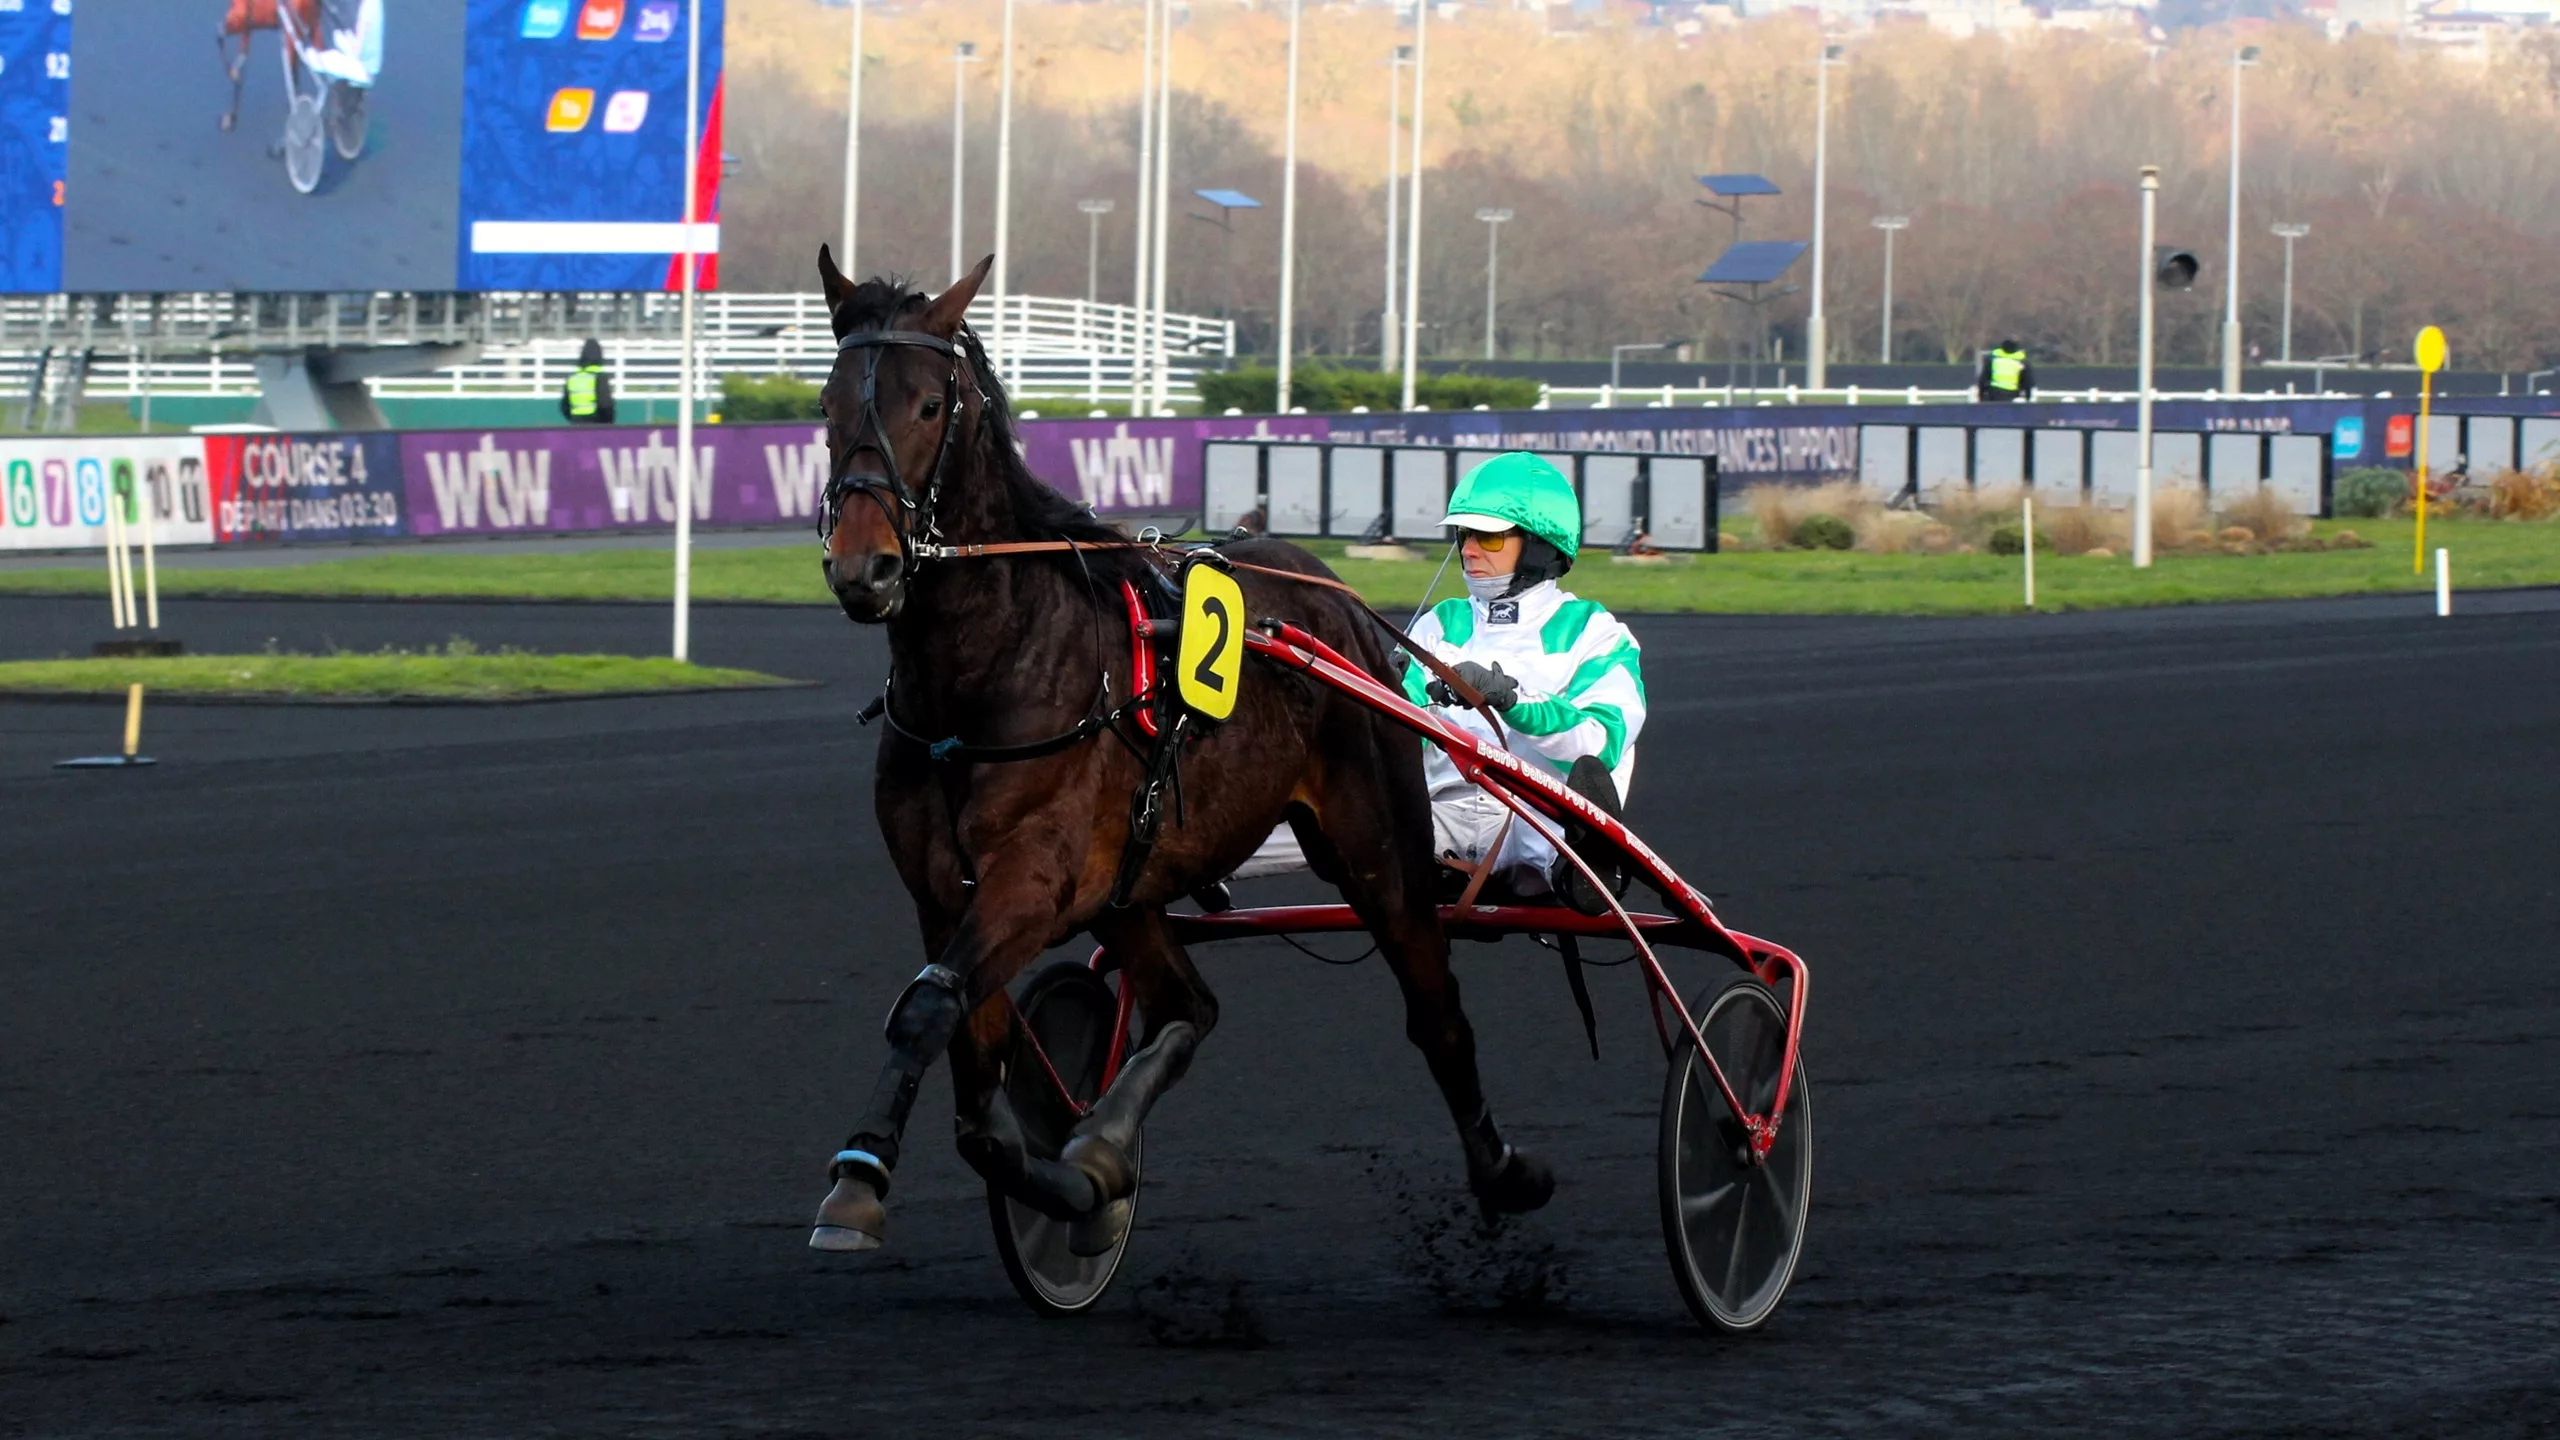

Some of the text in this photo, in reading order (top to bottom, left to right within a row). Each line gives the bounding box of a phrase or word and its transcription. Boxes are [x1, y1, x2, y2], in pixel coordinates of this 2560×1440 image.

[243, 442, 369, 488] COURSE 4
[1779, 426, 1859, 471] HIPPIQU
[13, 463, 35, 525] 6
[45, 463, 66, 525] 7
[80, 462, 104, 524] 8
[291, 498, 340, 531] DANS
[340, 491, 397, 528] 03:30
[1194, 596, 1229, 693] 2
